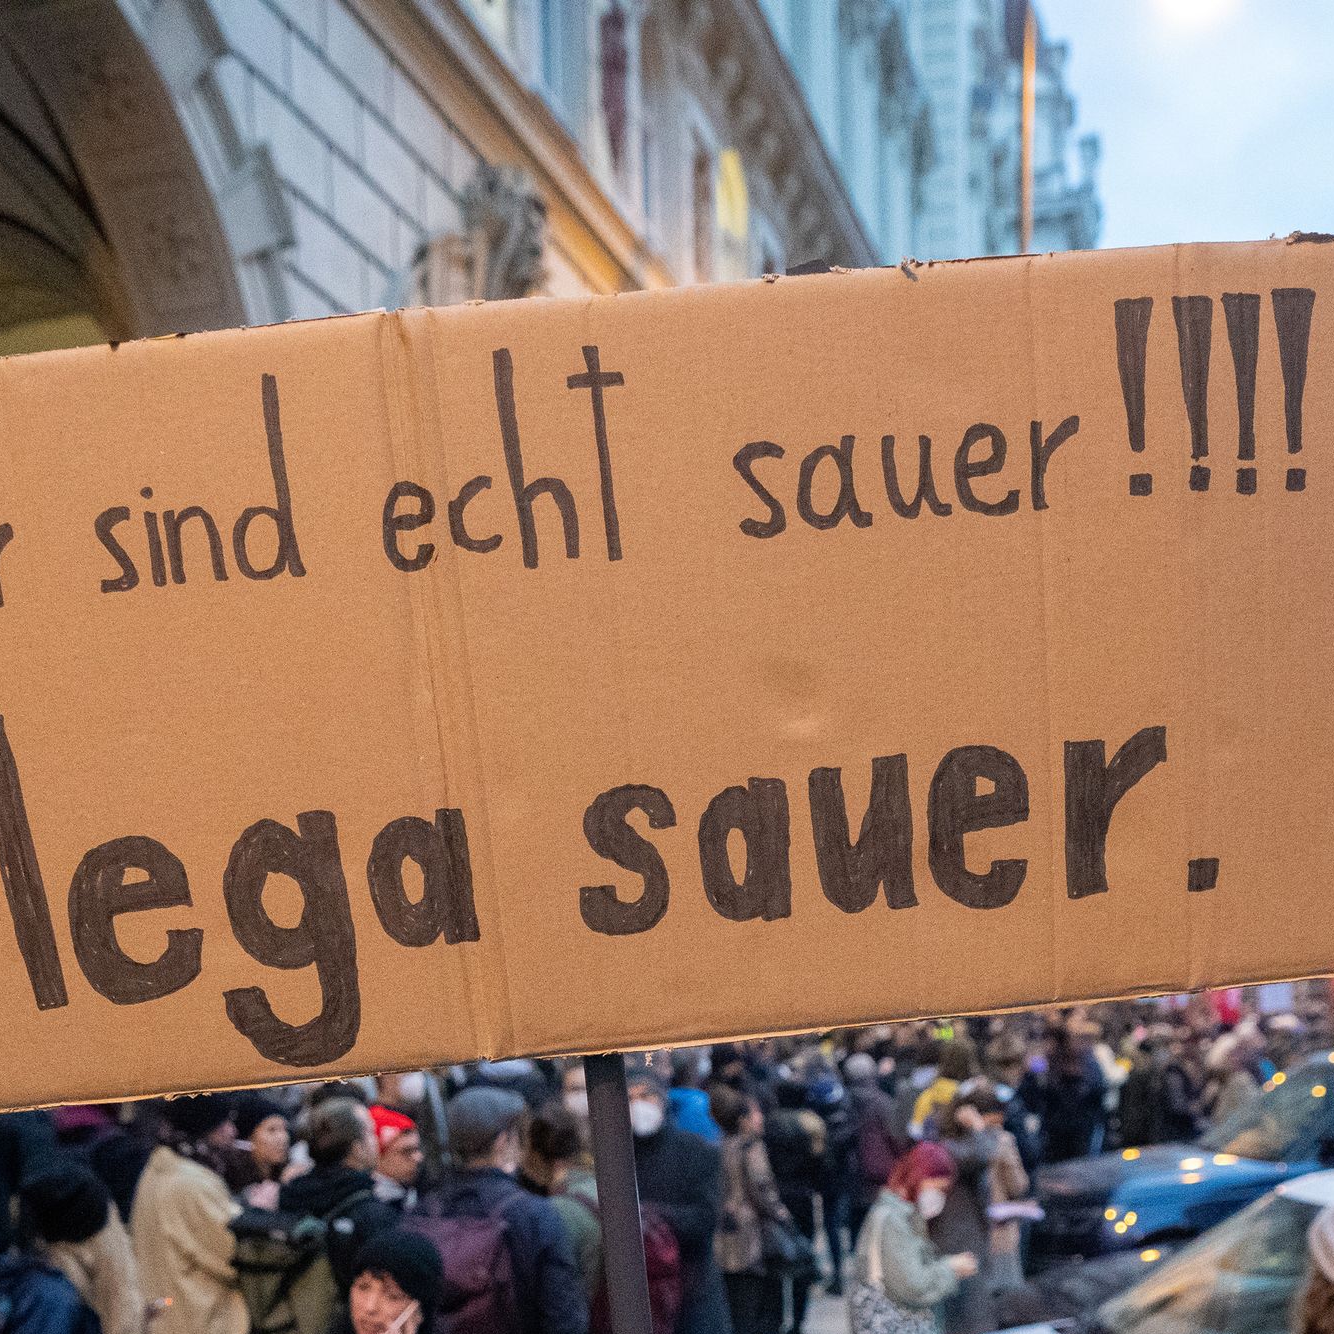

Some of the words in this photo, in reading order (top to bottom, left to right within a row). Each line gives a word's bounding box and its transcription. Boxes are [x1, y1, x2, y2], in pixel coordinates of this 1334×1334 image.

[95, 374, 306, 593] sind
[383, 346, 624, 572] echt
[580, 726, 1219, 936] sauer.
